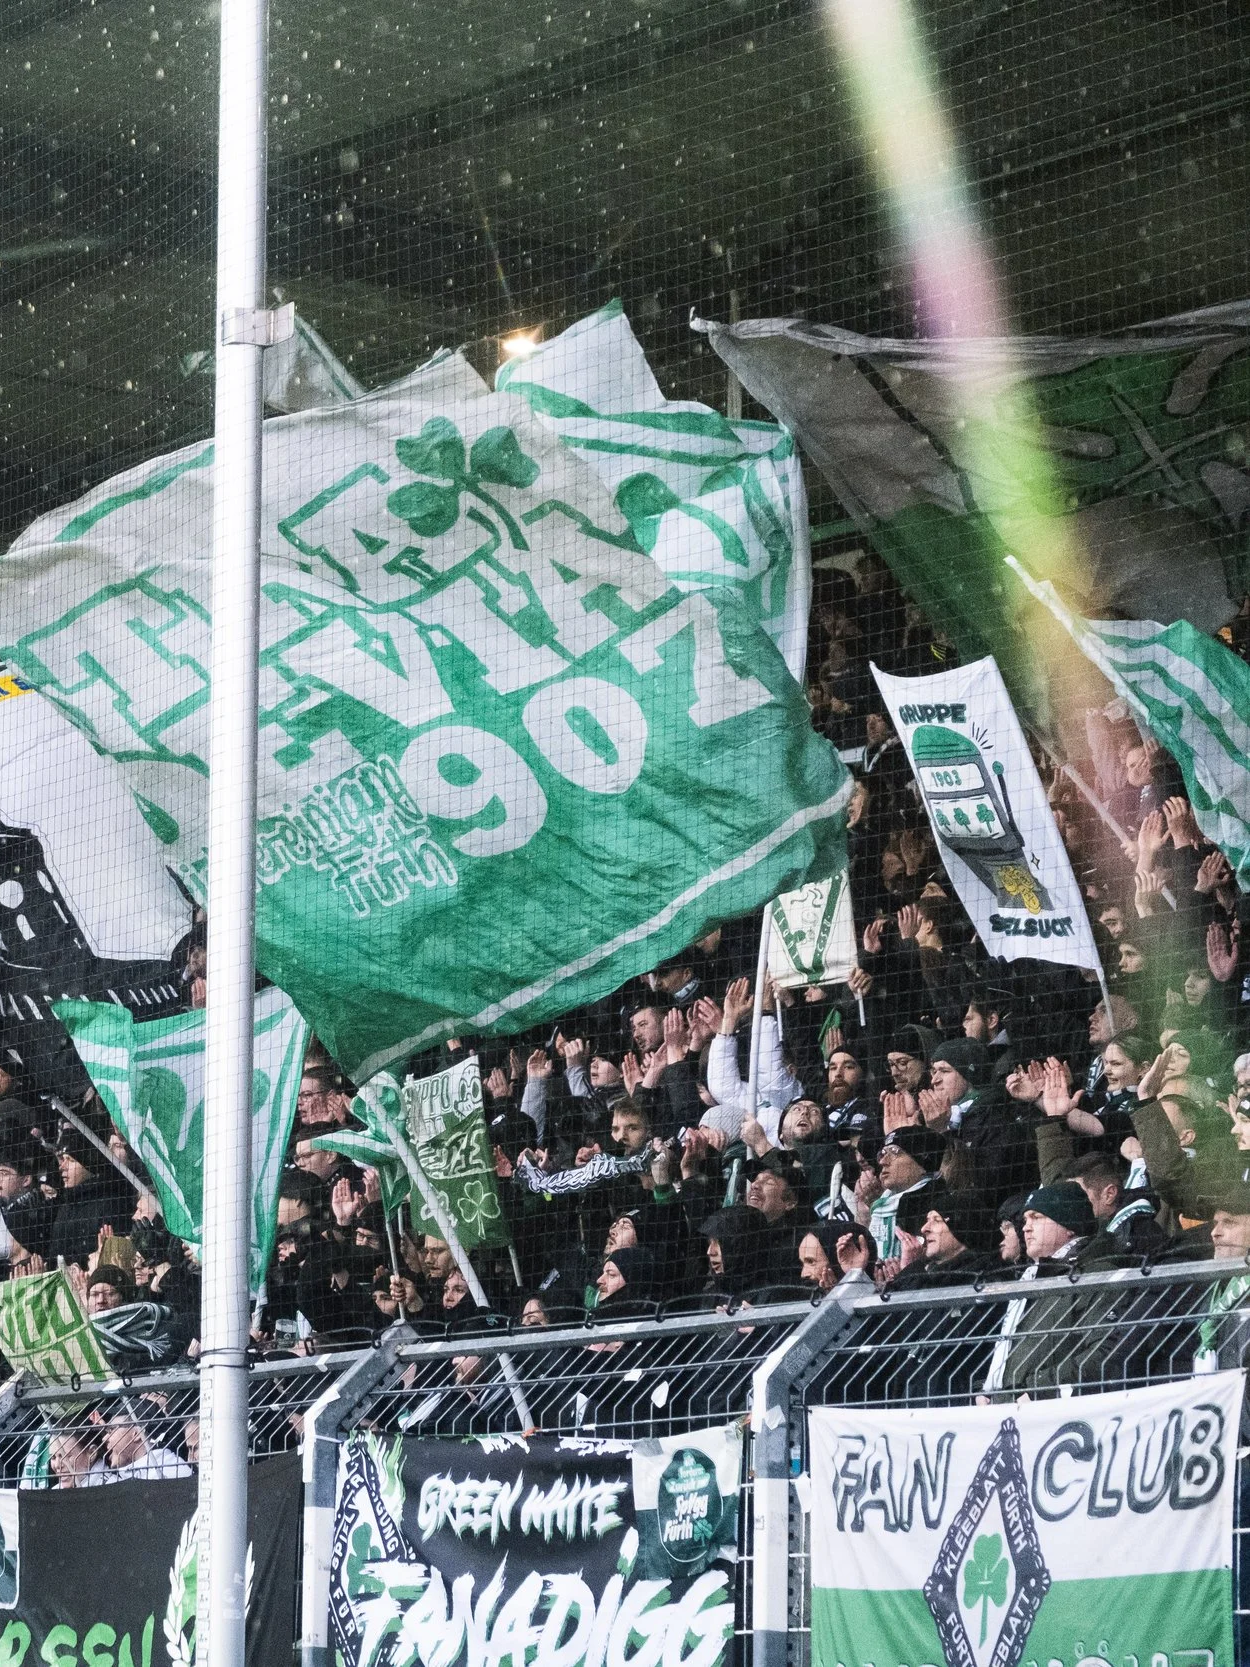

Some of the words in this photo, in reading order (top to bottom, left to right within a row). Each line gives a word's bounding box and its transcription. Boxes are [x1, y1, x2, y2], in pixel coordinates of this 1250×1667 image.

[899, 703, 966, 725] GRUPPE
[931, 769, 962, 787] 1903
[832, 1431, 956, 1533] FAN
[1032, 1403, 1224, 1522] CLUB
[418, 1469, 523, 1546] GREEN
[519, 1469, 629, 1543] WHITE
[664, 1516, 693, 1543] Fürth
[674, 1491, 709, 1521] SpVgg
[943, 1451, 1007, 1578] KLEEBLATT
[1001, 1480, 1028, 1554] FÜRTH
[946, 1612, 979, 1667] FÜRT
